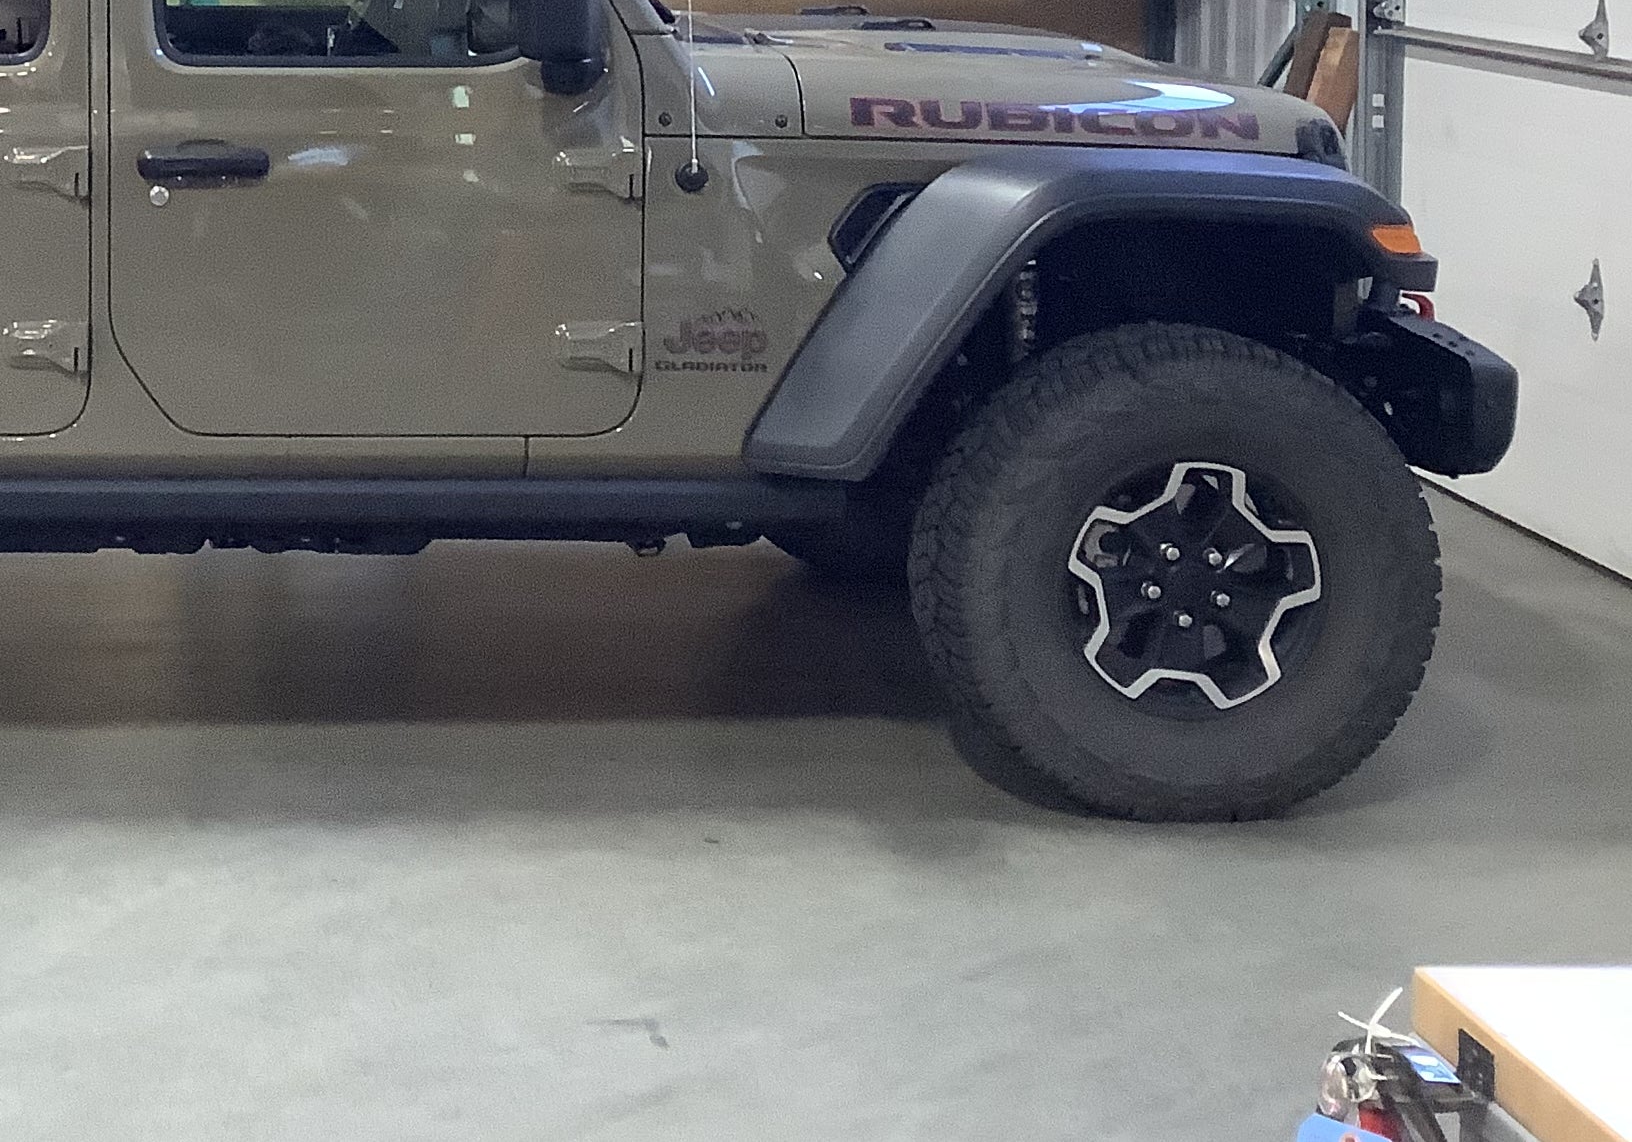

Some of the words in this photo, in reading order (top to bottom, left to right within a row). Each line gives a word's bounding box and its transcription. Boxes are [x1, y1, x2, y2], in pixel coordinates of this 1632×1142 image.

[849, 96, 1260, 141] RUBICON
[663, 320, 768, 360] Jeep
[654, 360, 768, 373] GLADIATOR
